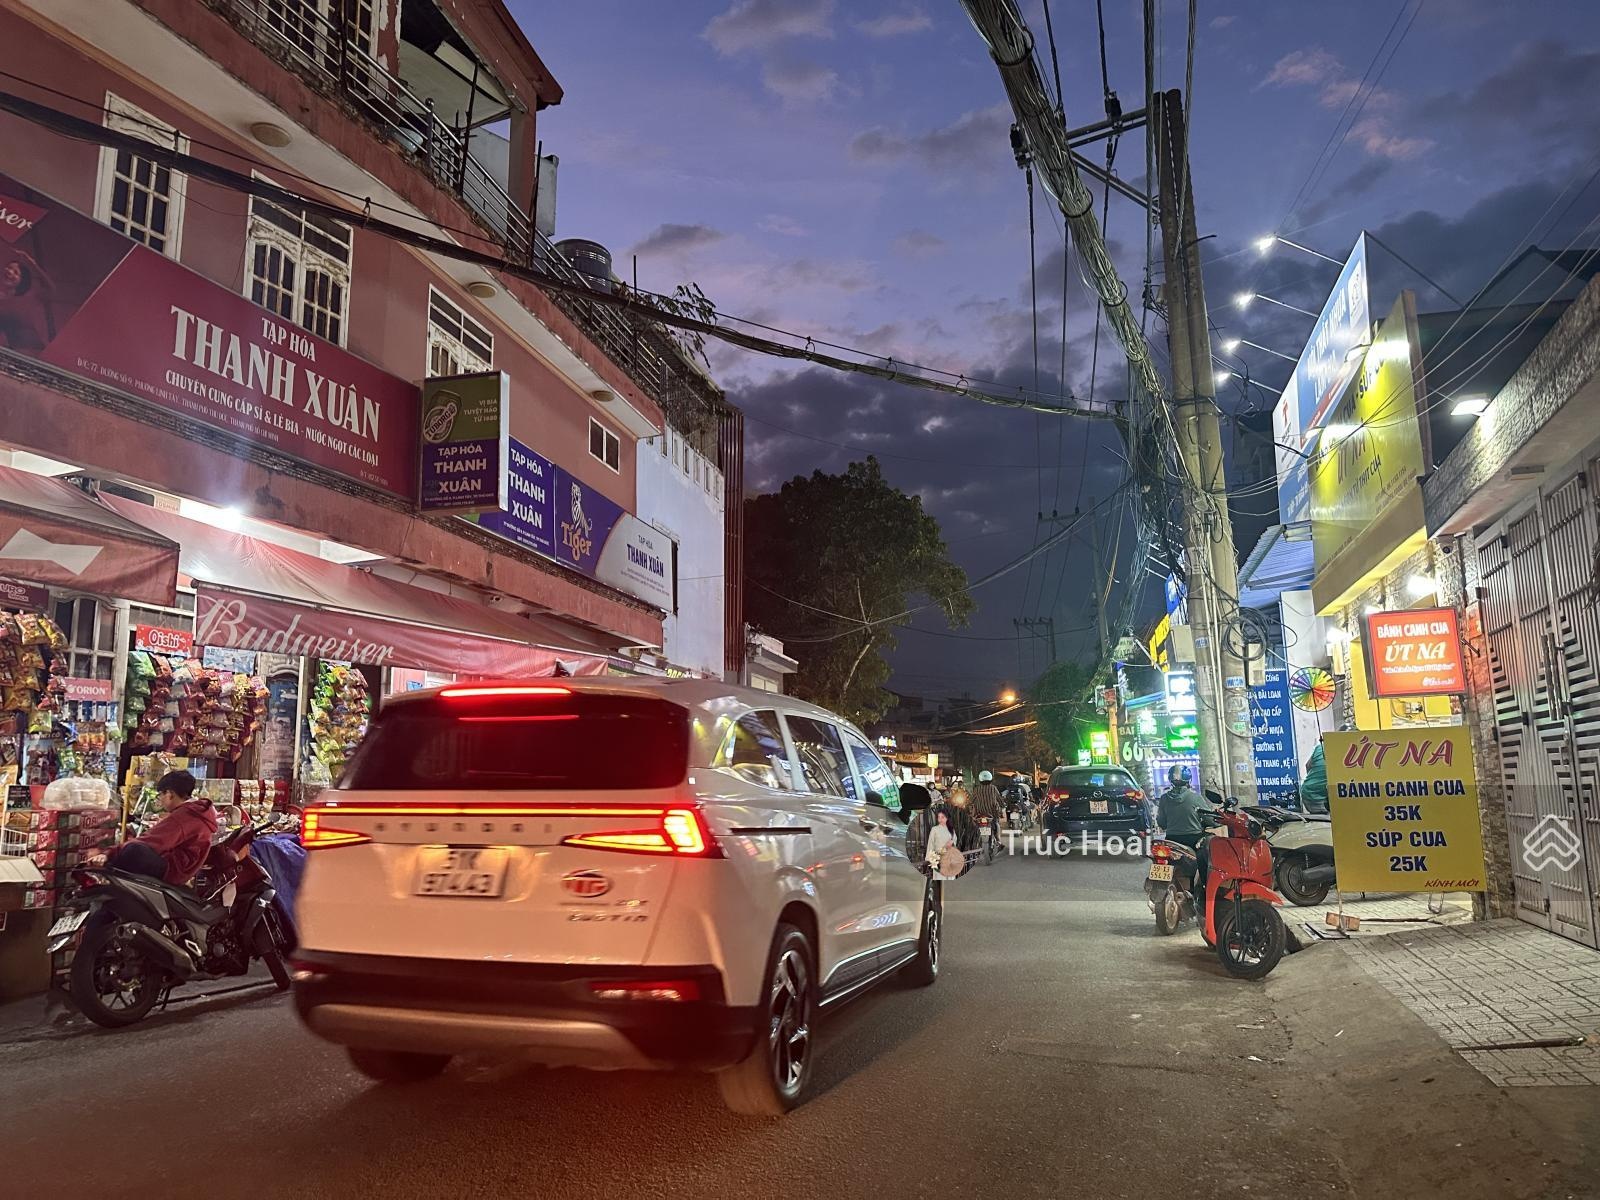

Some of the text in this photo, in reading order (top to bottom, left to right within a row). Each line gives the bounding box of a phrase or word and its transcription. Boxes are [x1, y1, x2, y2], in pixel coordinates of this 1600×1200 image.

[0, 201, 32, 229] ser
[262, 317, 316, 362] TẠP HÓA
[170, 305, 381, 443] THANH XUÂN
[166, 369, 207, 398] CHUYÊN
[208, 387, 233, 408] CUNG
[234, 397, 252, 415] CẤP
[264, 410, 271, 424] &
[285, 418, 299, 435] BIA
[305, 426, 327, 446] NƯỚC
[327, 435, 348, 455] NGỌT
[348, 443, 361, 460] CÁC
[362, 449, 379, 468] LOẠI
[438, 443, 482, 458] TẠP HÓA
[434, 458, 487, 474] THANH
[510, 448, 543, 477] TẠP HÓA
[439, 476, 482, 493] XUÂN
[508, 470, 545, 504] THANH
[512, 500, 542, 529] XUÂN
[561, 521, 592, 560] Tiger
[627, 543, 648, 570] THANH
[648, 555, 664, 578] XUÂN
[148, 629, 179, 648] Oishi
[195, 594, 394, 667] Budweiser
[1376, 621, 1449, 639] BÁNH CANH CUA
[1385, 640, 1446, 662] ÚT NA
[76, 684, 106, 695] ORION
[1267, 690, 1281, 699] LOAN
[1269, 724, 1284, 736] NHỰA
[1343, 735, 1454, 769] ÚT NA
[1337, 779, 1465, 798] BÁNH CANH CUA
[1384, 805, 1422, 821] 35K
[1365, 828, 1447, 848] SÚP CUA
[1389, 855, 1428, 872] 25K
[1424, 878, 1453, 888] KÍNH
